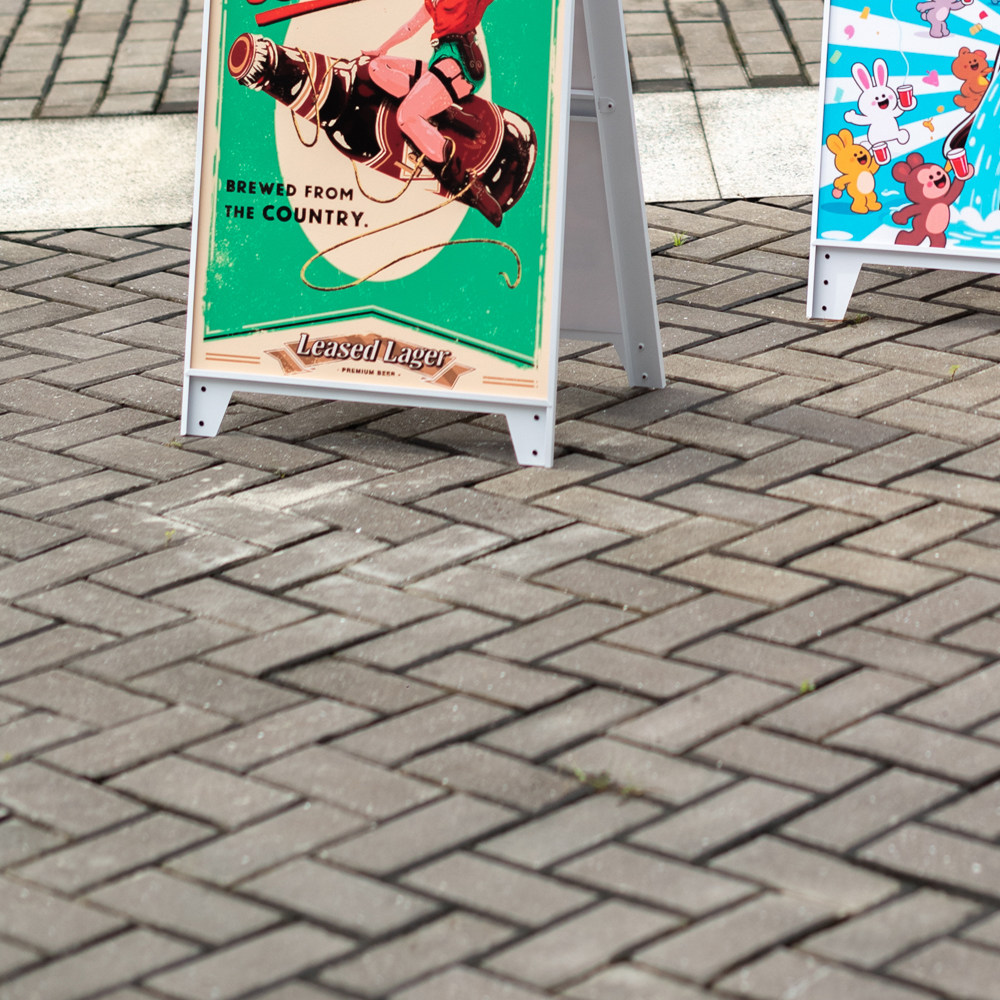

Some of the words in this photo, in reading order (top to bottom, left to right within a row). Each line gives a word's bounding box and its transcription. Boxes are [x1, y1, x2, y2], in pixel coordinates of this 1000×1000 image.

[226, 179, 297, 197] BREWED
[305, 185, 354, 201] FROM
[225, 204, 255, 219] THE
[262, 204, 369, 228] COUNTRY.
[296, 332, 382, 362] Leased
[383, 340, 452, 370] Lager
[341, 367, 375, 376] PREMIUM
